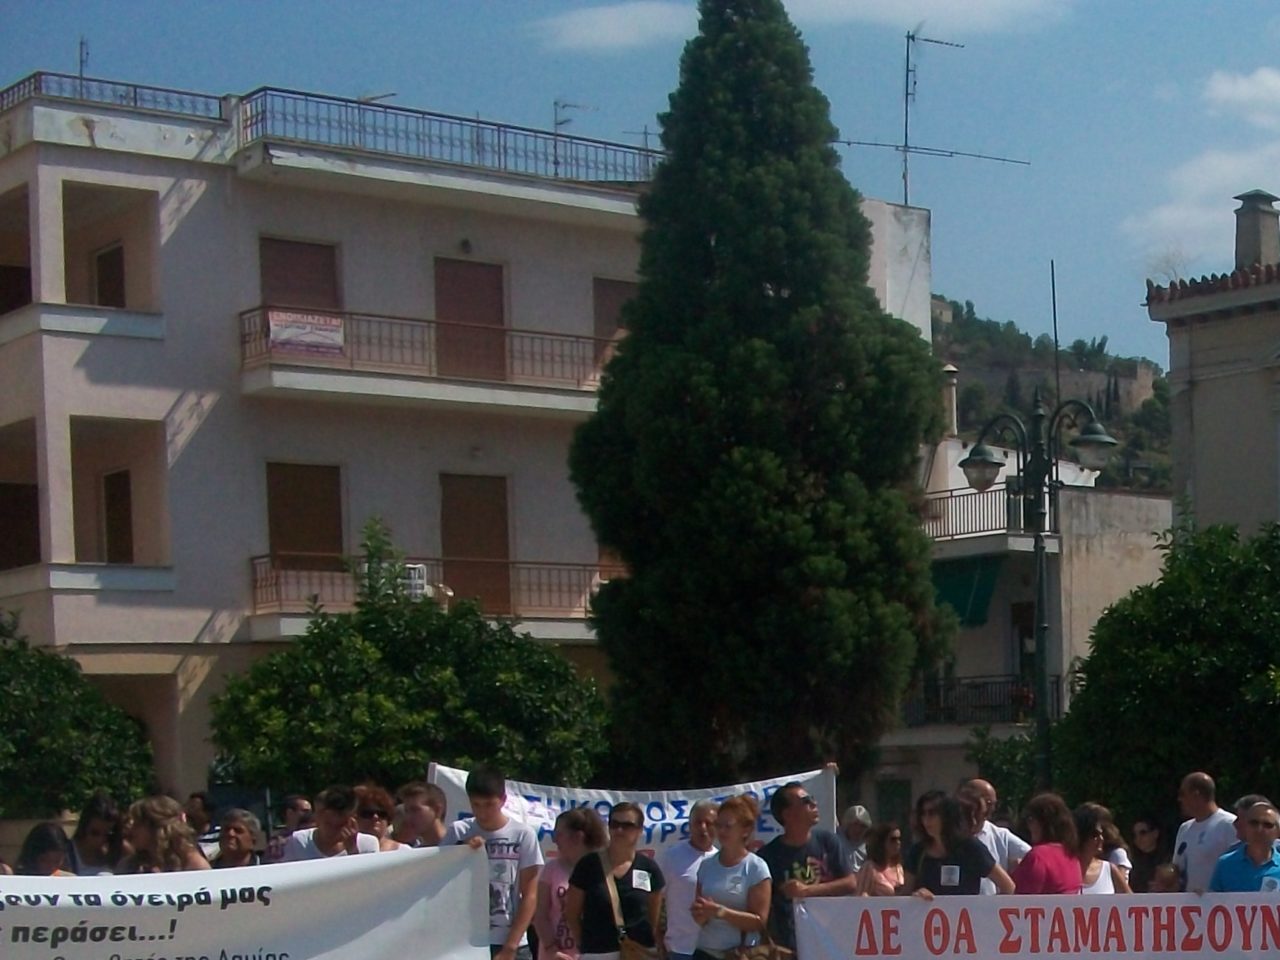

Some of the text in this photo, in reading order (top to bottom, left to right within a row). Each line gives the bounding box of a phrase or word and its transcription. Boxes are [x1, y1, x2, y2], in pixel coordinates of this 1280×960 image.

[68, 894, 102, 906] τα
[110, 887, 211, 911] όνειρά
[220, 886, 272, 909] μας
[11, 919, 177, 948] περάσει...!
[855, 909, 901, 955] ΔΕ
[924, 908, 976, 954] ΘΑ
